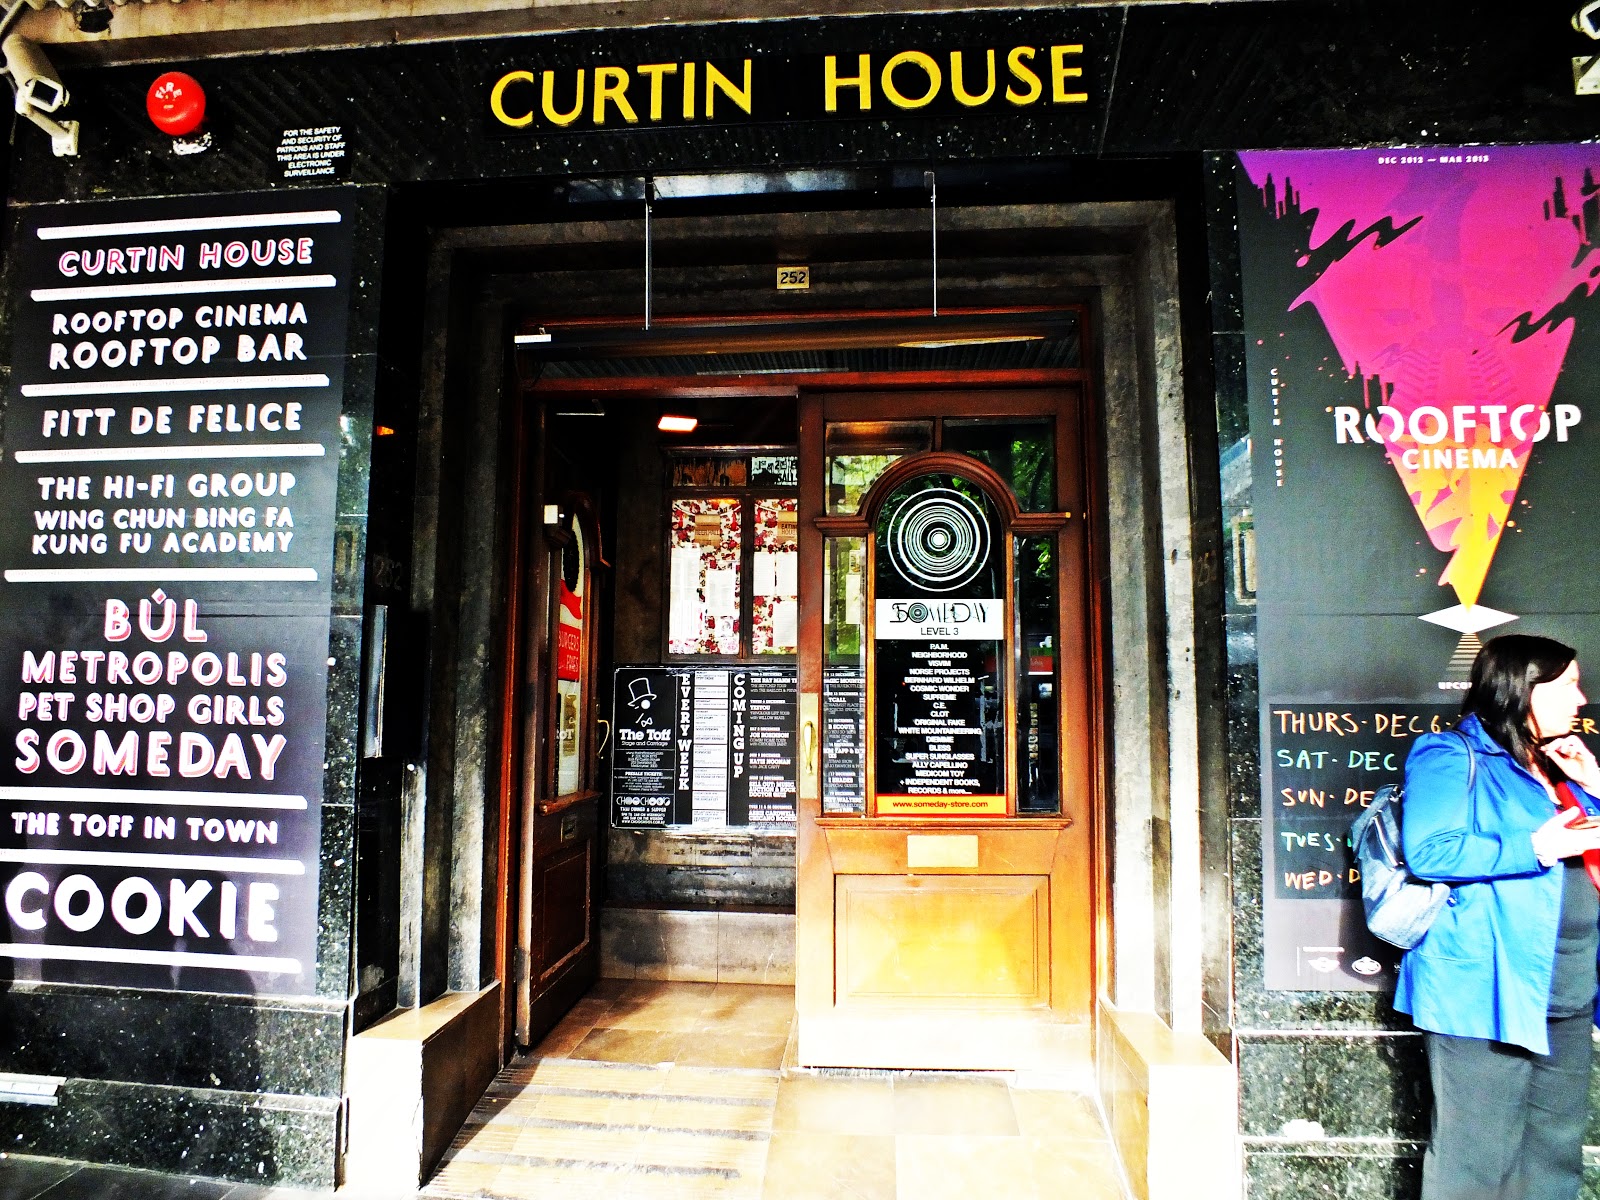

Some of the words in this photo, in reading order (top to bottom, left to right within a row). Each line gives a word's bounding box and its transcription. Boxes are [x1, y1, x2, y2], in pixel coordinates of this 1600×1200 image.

[155, 82, 183, 98] FIRE
[490, 59, 752, 129] CURTIN
[824, 44, 1089, 113] HOUSE
[283, 129, 298, 137] FOR
[300, 128, 313, 136] THE
[314, 126, 341, 135] SAFETY
[297, 135, 332, 144] SECURITY
[276, 145, 308, 153] PATRONS
[309, 143, 324, 151] AND
[324, 142, 346, 150] STAFF
[293, 152, 312, 160] AREA
[312, 151, 320, 159] IS
[320, 150, 345, 158] UNDER
[288, 159, 332, 169] ELECTRONIC
[1378, 156, 1397, 164] DEC
[1400, 156, 1424, 164] 2012
[1439, 155, 1462, 163] MAR
[284, 167, 335, 178] SURVEILLANCE
[59, 245, 184, 277] CURTIN
[200, 238, 313, 270] HOUSE
[780, 271, 807, 284] 252
[52, 307, 183, 335] ROOFTOP
[195, 302, 308, 328] CINEMA
[50, 336, 220, 370] ROOFTOP
[237, 333, 307, 362] BAR
[43, 408, 116, 437] FITT
[130, 406, 172, 434] DE
[189, 402, 302, 433] FELICE
[1334, 404, 1582, 444] ROOFTOP
[1402, 447, 1518, 469] CINEMA
[38, 477, 91, 500] THE
[104, 474, 174, 499] HI-FI
[188, 472, 296, 497] GROUP
[34, 509, 104, 530] WING
[113, 508, 185, 529] CHUN
[195, 507, 255, 528] BING
[265, 507, 294, 528] FA
[32, 534, 107, 555] KUNG
[120, 533, 151, 554] FU
[163, 532, 294, 553] ACADEMY
[890, 602, 988, 623] SOMEDAY
[920, 627, 951, 636] LEVEL
[953, 627, 959, 636] 3
[22, 651, 288, 687] METROPOLIS
[1438, 681, 1472, 689] UPCO
[18, 692, 75, 721] PET
[86, 693, 175, 723] SHOP
[188, 694, 286, 726] GIRLS
[619, 729, 644, 740] The
[646, 729, 671, 741] Toff
[1375, 713, 1423, 737] DEC
[1569, 717, 1600, 735] ER
[15, 728, 288, 781] SOMEDAY
[1348, 750, 1397, 771] DEC
[892, 801, 988, 809] www.someday-store.com
[1344, 787, 1375, 808] DE
[12, 812, 60, 836] THE
[70, 813, 134, 838] TOFF
[144, 816, 175, 839] IN
[186, 818, 279, 844] TOWN
[6, 872, 280, 942] COOKIE
